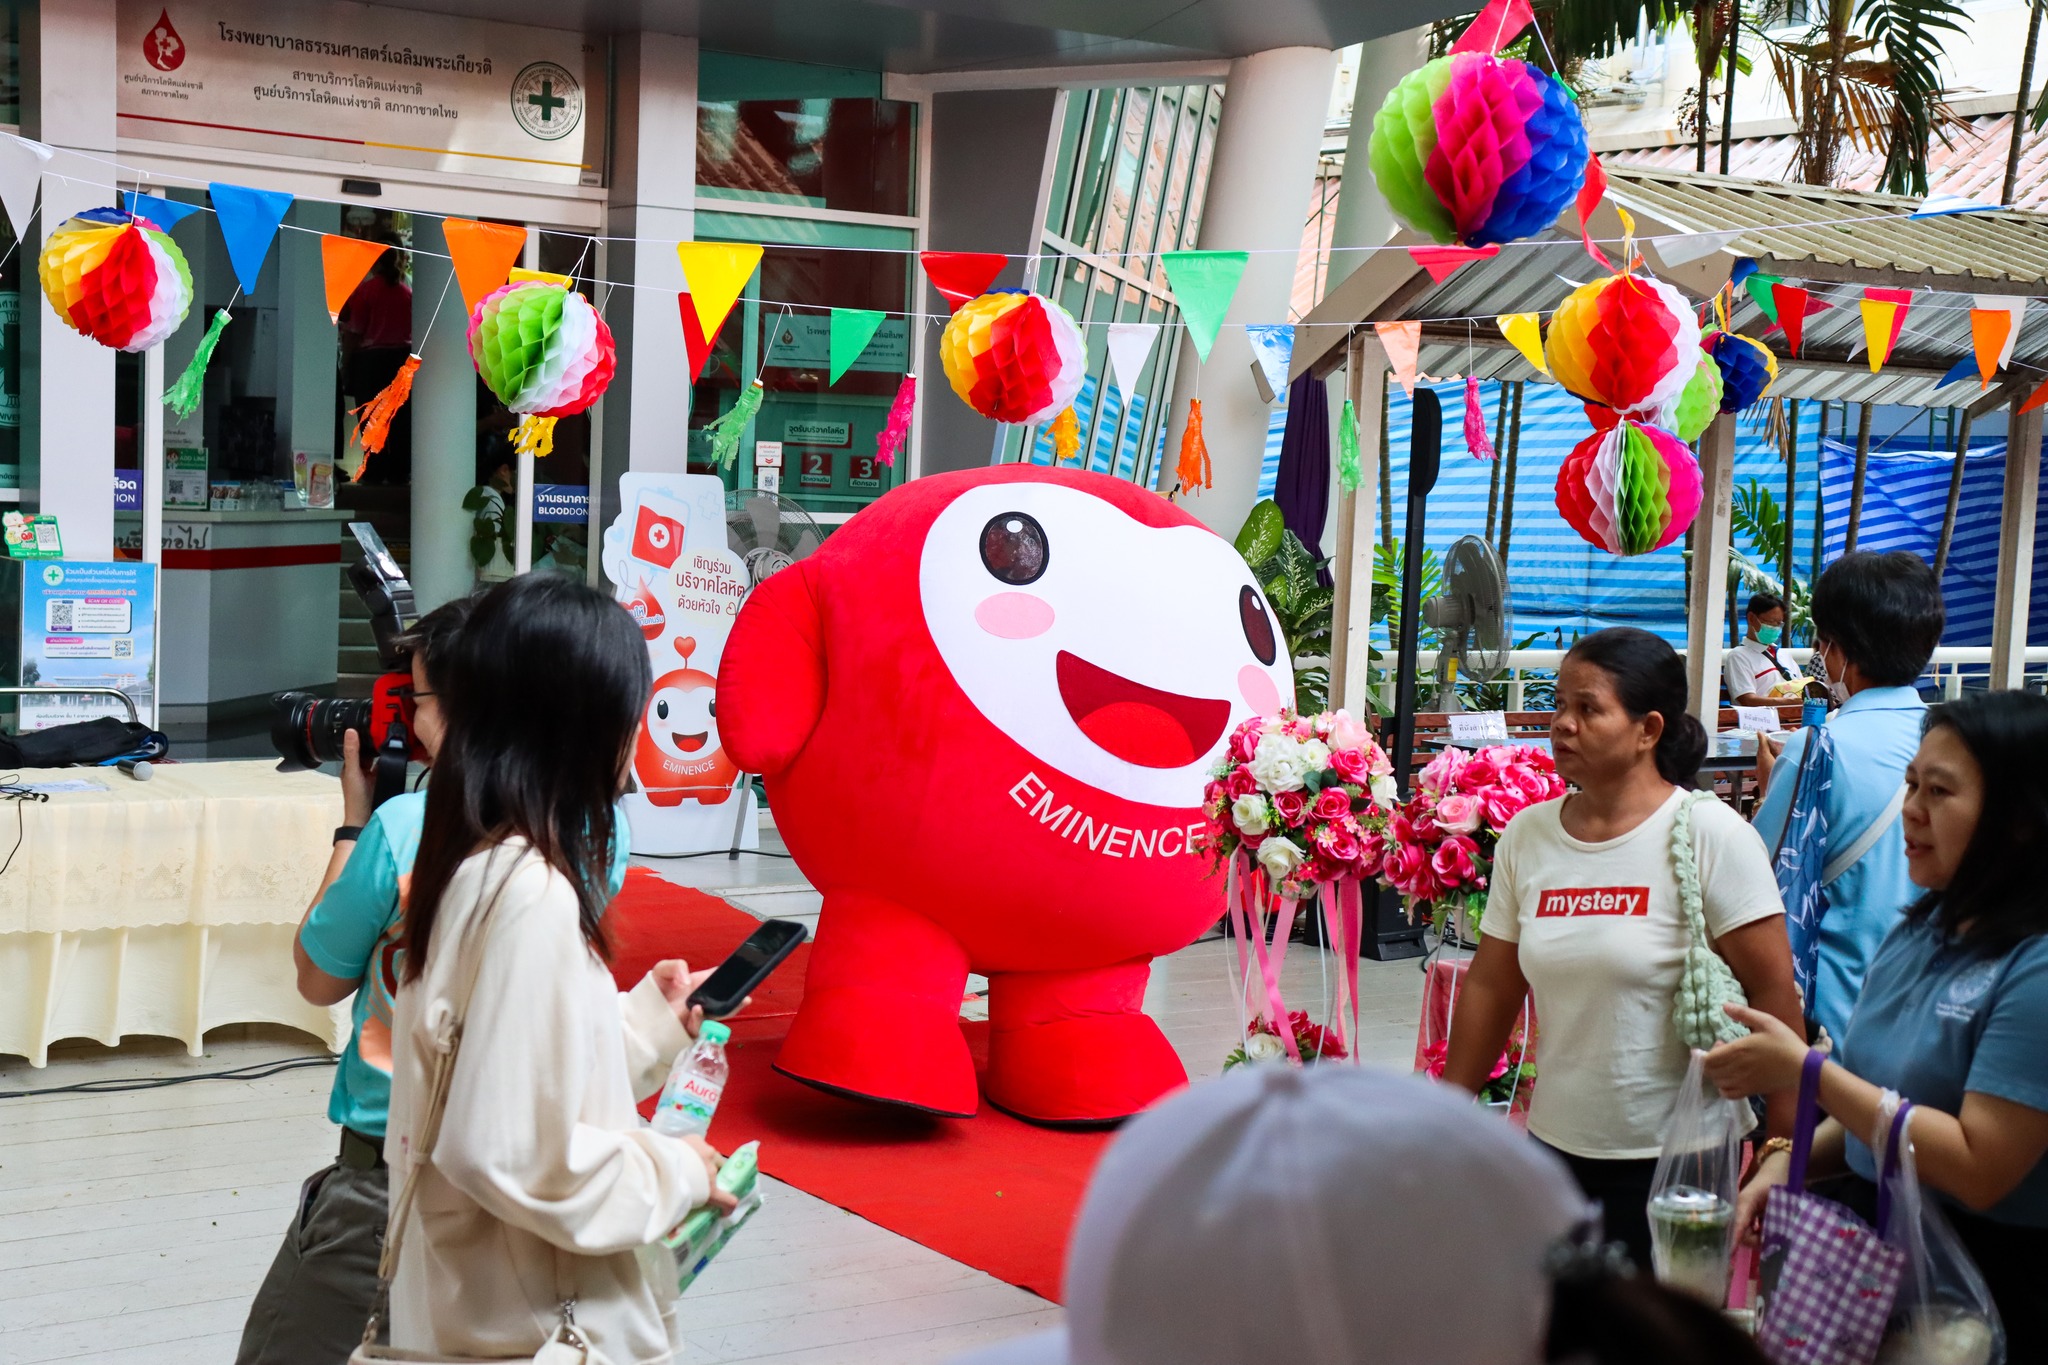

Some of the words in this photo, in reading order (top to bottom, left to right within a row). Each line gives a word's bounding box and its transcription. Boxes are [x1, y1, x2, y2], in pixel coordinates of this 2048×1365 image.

[218, 21, 492, 76] โรงพยาบาลธรรมศาสตร์เฉลิมพระเกียรติ
[124, 73, 204, 91] ศูนย์บริการโลหิตแห่งชาติ
[292, 70, 423, 96] สาขาบริการโลหิตแห่งชาติ
[141, 87, 189, 101] สภากาชาดไทย
[253, 85, 381, 111] ศูนย์บริการโลหิตแห่งชาติ
[385, 99, 458, 120] สภากาชาดไทย
[561, 113, 575, 131] HOSPITAL
[788, 424, 845, 436] จุดรับบริจาคโลหิต
[809, 455, 823, 475] 2
[859, 458, 873, 479] 3
[113, 493, 136, 503] ION
[693, 555, 732, 575] เชิญร่วม
[675, 571, 745, 598] บริจาคโลหิต
[677, 594, 721, 616] ด้วยหัวใจ
[662, 759, 716, 776] EMINENCE
[1008, 771, 1207, 859] EMINENCE
[1545, 890, 1640, 917] mystery
